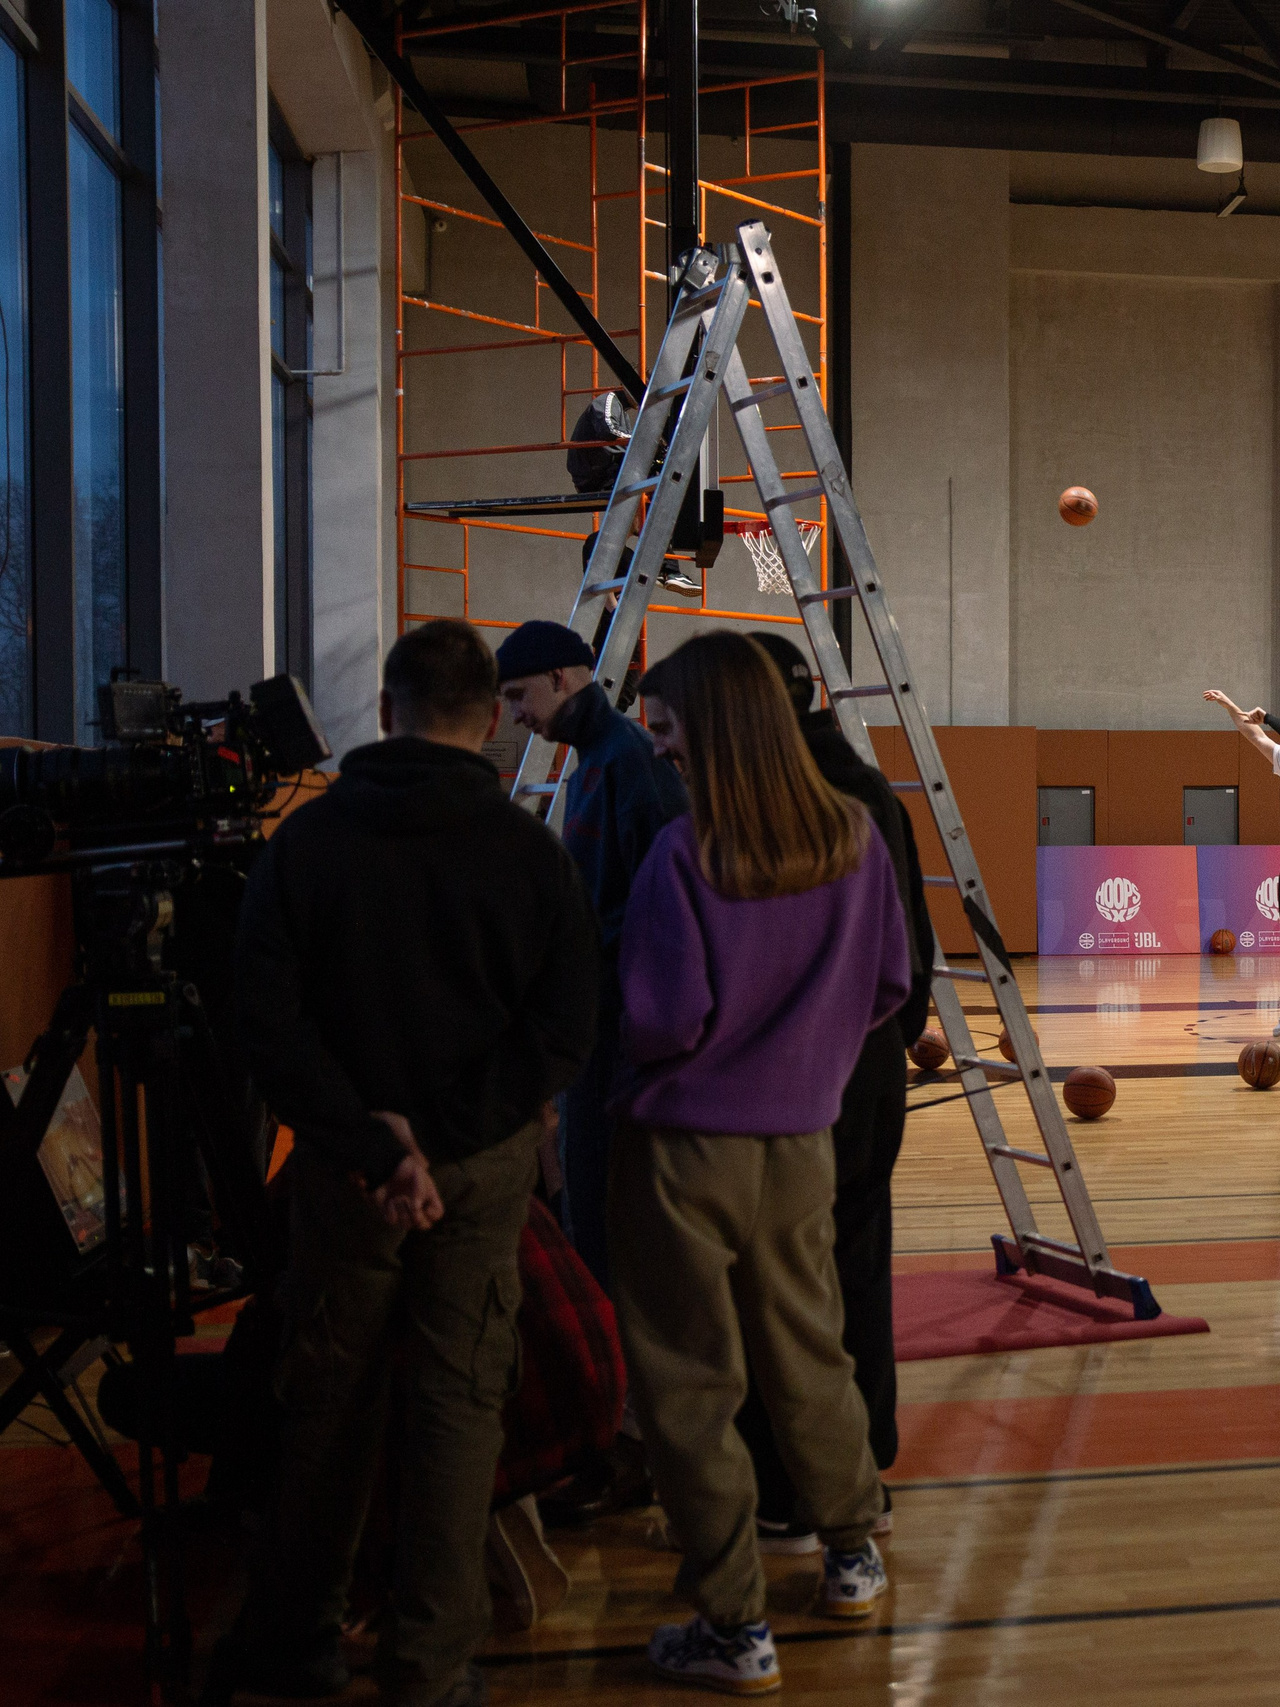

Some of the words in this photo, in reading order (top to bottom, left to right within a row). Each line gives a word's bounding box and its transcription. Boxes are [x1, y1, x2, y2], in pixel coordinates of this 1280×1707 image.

[1095, 877, 1141, 910] HOOPS
[1255, 876, 1280, 909] HOO
[1135, 932, 1161, 948] JBL
